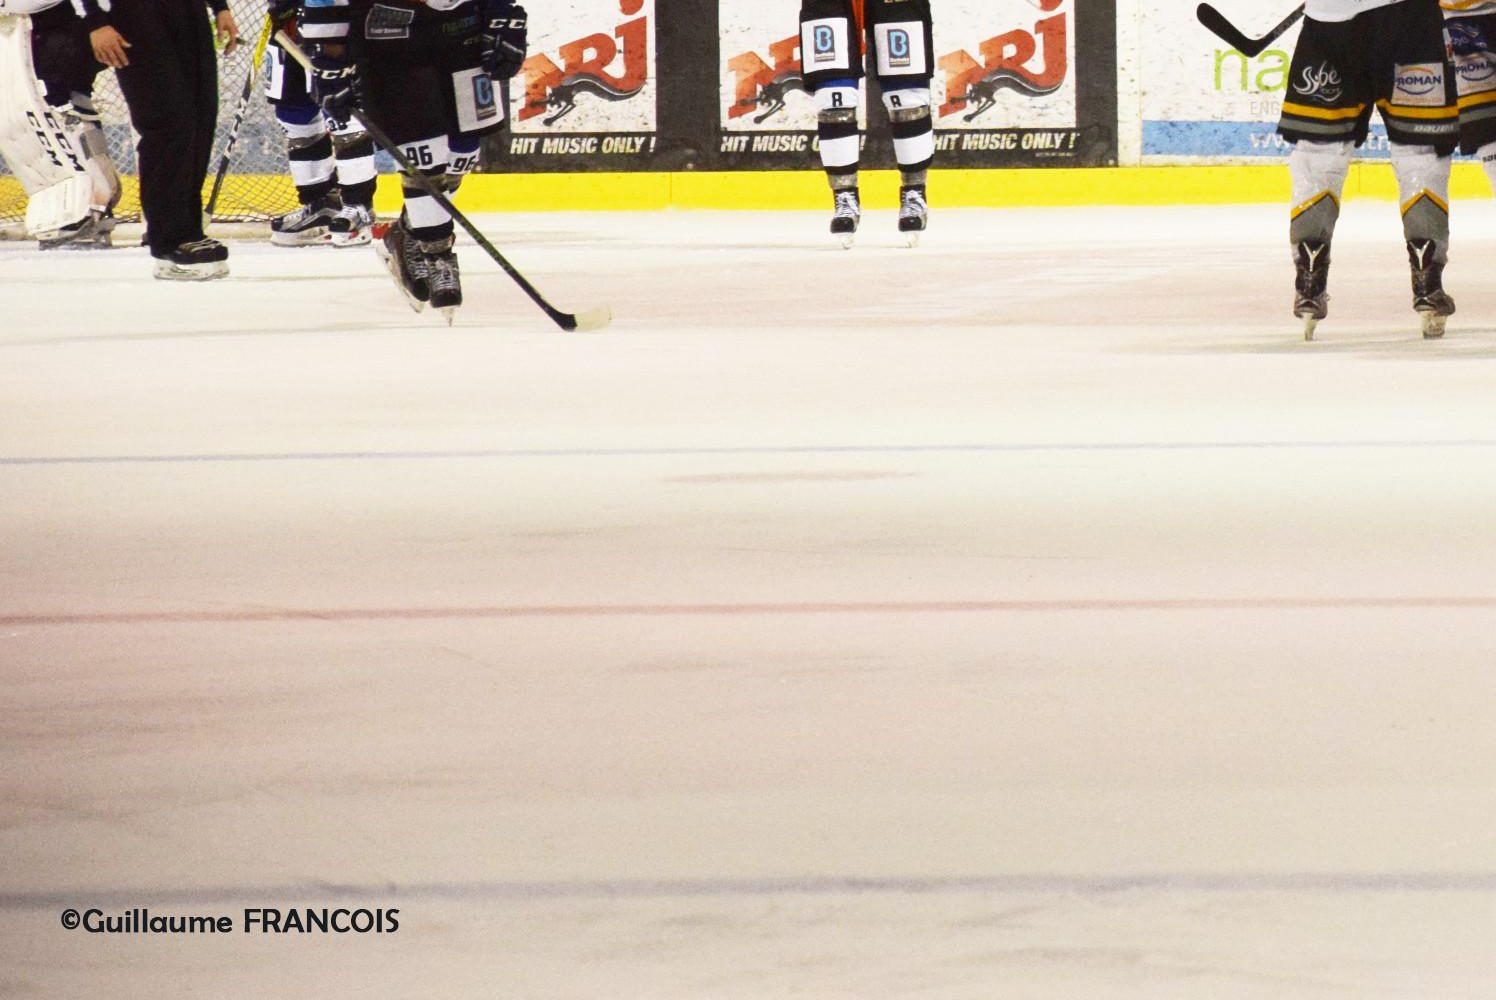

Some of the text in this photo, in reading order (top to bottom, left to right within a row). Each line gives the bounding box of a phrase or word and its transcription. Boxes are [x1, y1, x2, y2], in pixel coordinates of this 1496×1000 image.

[489, 18, 527, 30] CC
[509, 137, 540, 155] HIT
[541, 136, 599, 155] MUSIC
[601, 136, 648, 154] ONLY
[720, 135, 749, 153] HIT
[751, 135, 809, 153] MUSIC
[932, 134, 960, 151] HIT
[961, 133, 1019, 150] MUSIC
[1021, 132, 1065, 150] ONLY
[406, 144, 433, 168] 96
